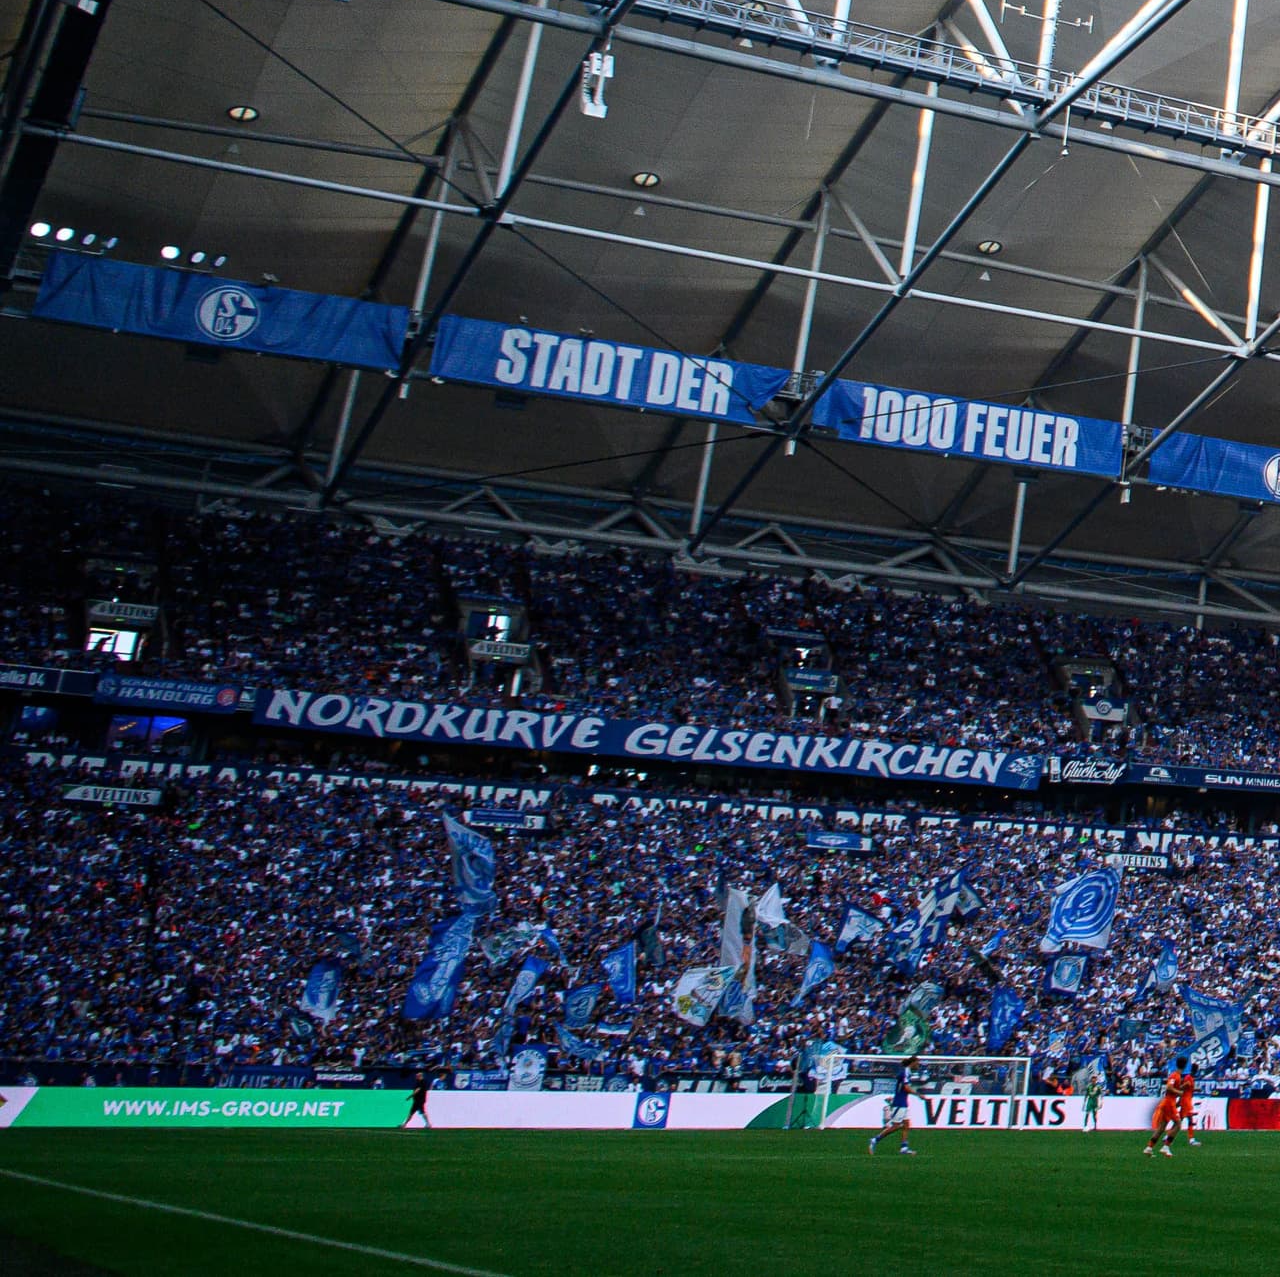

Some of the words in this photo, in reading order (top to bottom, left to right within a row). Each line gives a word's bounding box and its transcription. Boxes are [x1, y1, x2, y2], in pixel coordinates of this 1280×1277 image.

[496, 328, 644, 403] STADT
[646, 351, 732, 416] DER
[861, 386, 959, 450] 1000
[962, 401, 1080, 468] FEUER
[117, 688, 215, 706] HAMBURG
[266, 689, 605, 749] NORDKURVE
[624, 722, 1007, 785] GELSENKIRCHEN
[1204, 774, 1244, 786] SUN
[91, 788, 151, 805] VELTINS
[1121, 854, 1163, 869] VELTINS
[103, 1099, 345, 1118] WWW.IMS-GROUP.NET
[923, 1097, 1066, 1127] VELTINS
